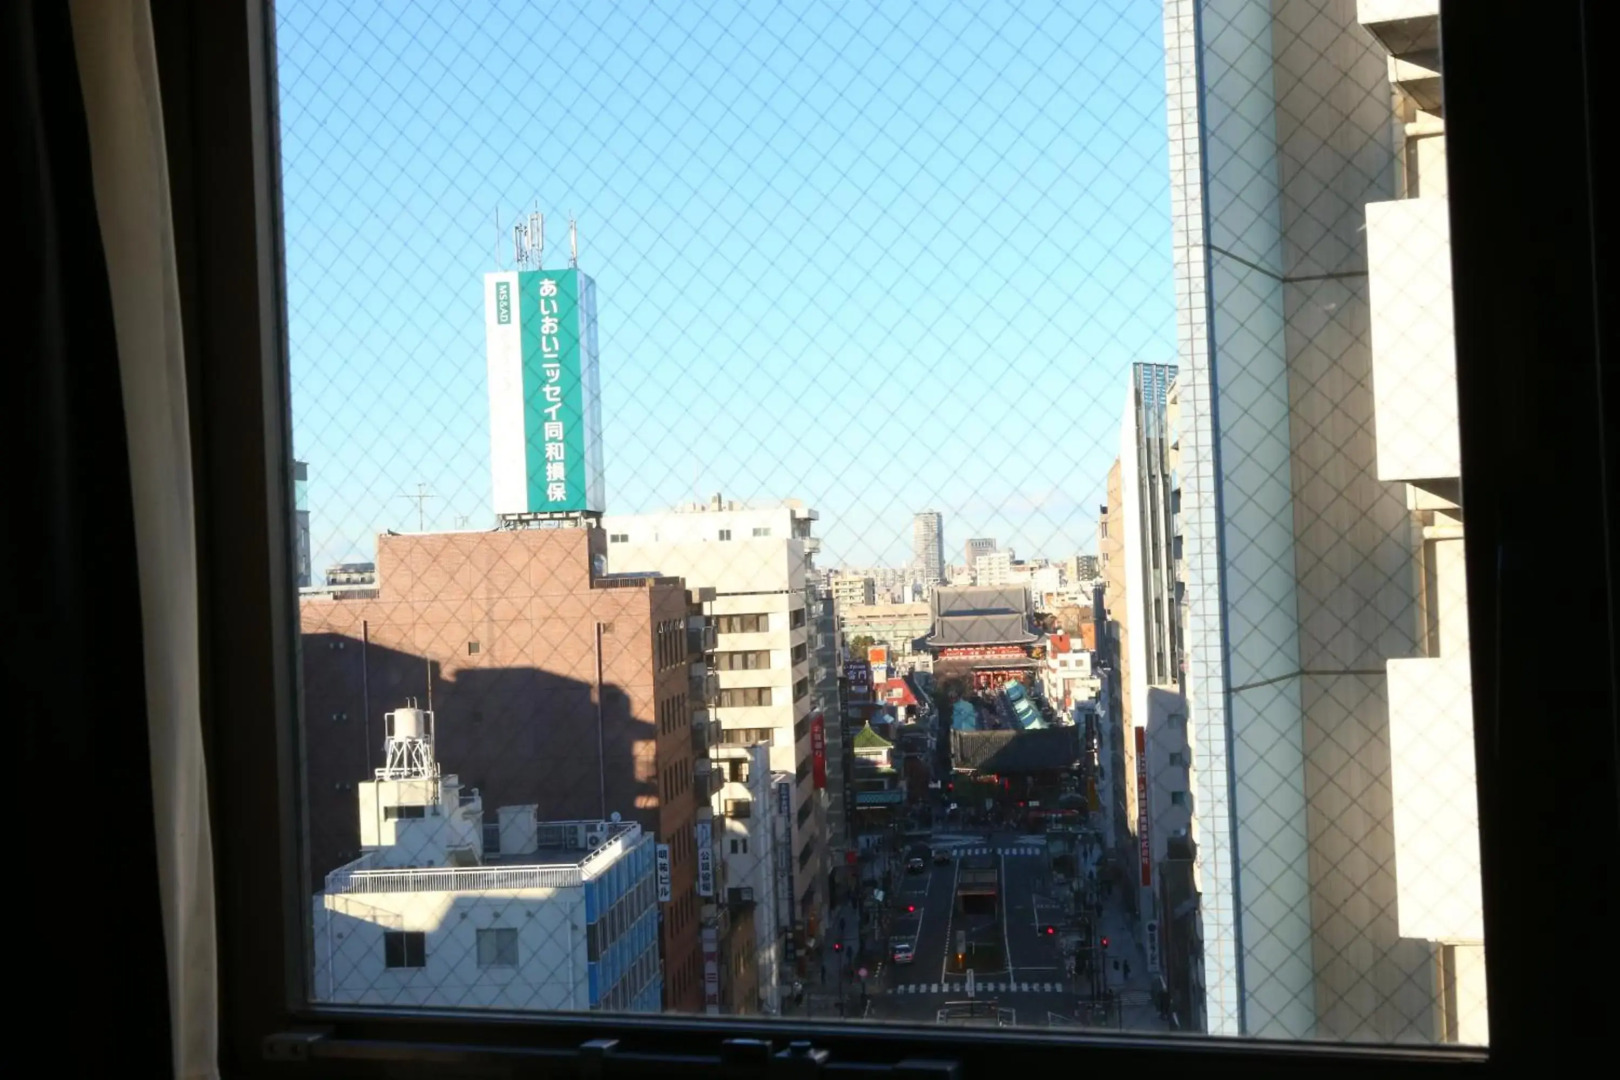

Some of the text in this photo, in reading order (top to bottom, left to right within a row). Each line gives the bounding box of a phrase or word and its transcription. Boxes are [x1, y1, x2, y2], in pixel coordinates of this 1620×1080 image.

[498, 284, 510, 323] MS&AD
[538, 278, 567, 502] あいおいニッセイ同和損保
